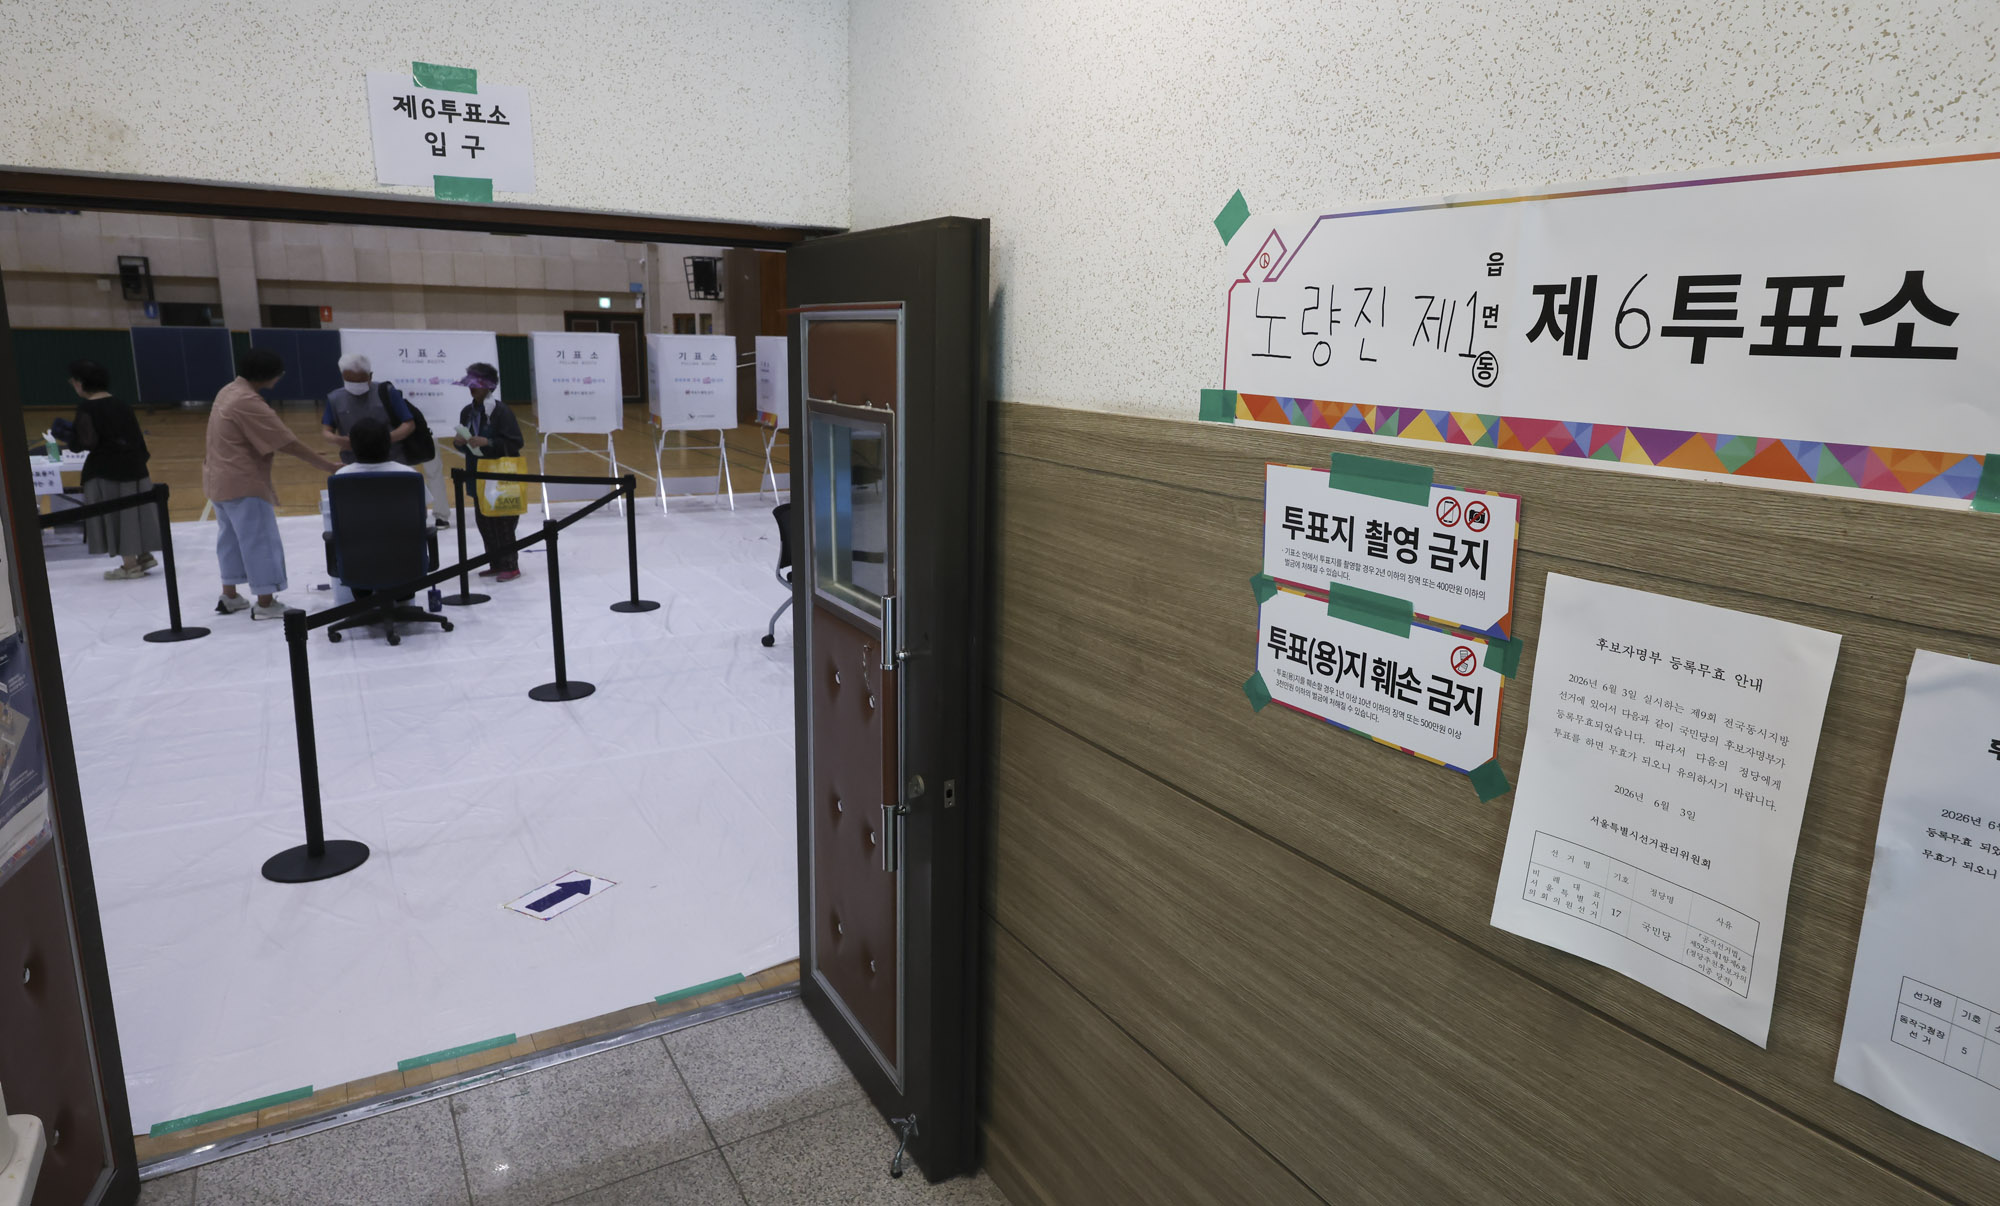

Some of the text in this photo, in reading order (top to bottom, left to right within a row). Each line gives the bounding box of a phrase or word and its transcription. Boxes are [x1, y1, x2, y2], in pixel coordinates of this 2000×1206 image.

[392, 95, 510, 126] 제6투표소
[1487, 252, 1504, 276] 읍
[1252, 285, 1385, 366] 노량진
[1483, 304, 1499, 328] 면
[1477, 357, 1494, 380] 동
[1282, 506, 1489, 581] 투표지 촬영 금지
[1284, 559, 1350, 580] 벌금에 처해질 수 있습니다.
[1285, 548, 1486, 600] 기표소 안에서 투표지를 촬영할 경우 2년 이하의 징역 또는 400만원 이하의
[1268, 626, 1483, 726] 투표(용)지 훼손 금지
[1596, 637, 1763, 693] 후보자명부 등록무효 안내
[1276, 678, 1379, 723] 3천만원 이하의 벌금에 처해질 수 있습니다.
[1276, 669, 1462, 739] 투표(용)지를 훼손할 경우 1년 이상 10년 이하의 징역 또는 500만원 이상
[1568, 674, 1789, 747] 2026년 6월 3일 실시하는 제9회 전국동시지방
[1559, 691, 1786, 769] 선거에 있어서 다음과 같이 국민당의 후보자명부가
[1556, 709, 1782, 791] 등록무효되었습니다. 따라서 다음의 정당에게
[1554, 728, 1777, 812] 투표를 하면 무효가 되오니 유의하시기 바랍니다.
[1614, 785, 1696, 821] 2026년 6월 3일
[1941, 808, 1982, 826] 2026년
[1590, 815, 1711, 870] 서울특별시선거관리위원회
[1926, 828, 1972, 848] 등록무효
[1922, 849, 1997, 880] 무효가 되오니
[1611, 908, 1621, 917] 17
[1614, 872, 1629, 884] 기호
[1650, 888, 1674, 904] 정당명
[1716, 918, 1732, 930] 사유
[1642, 922, 1671, 941] 국민당
[1914, 991, 1981, 1024] 선거명 기호
[1900, 1015, 1945, 1039] 동작구청장
[1961, 1046, 1967, 1055] 5
